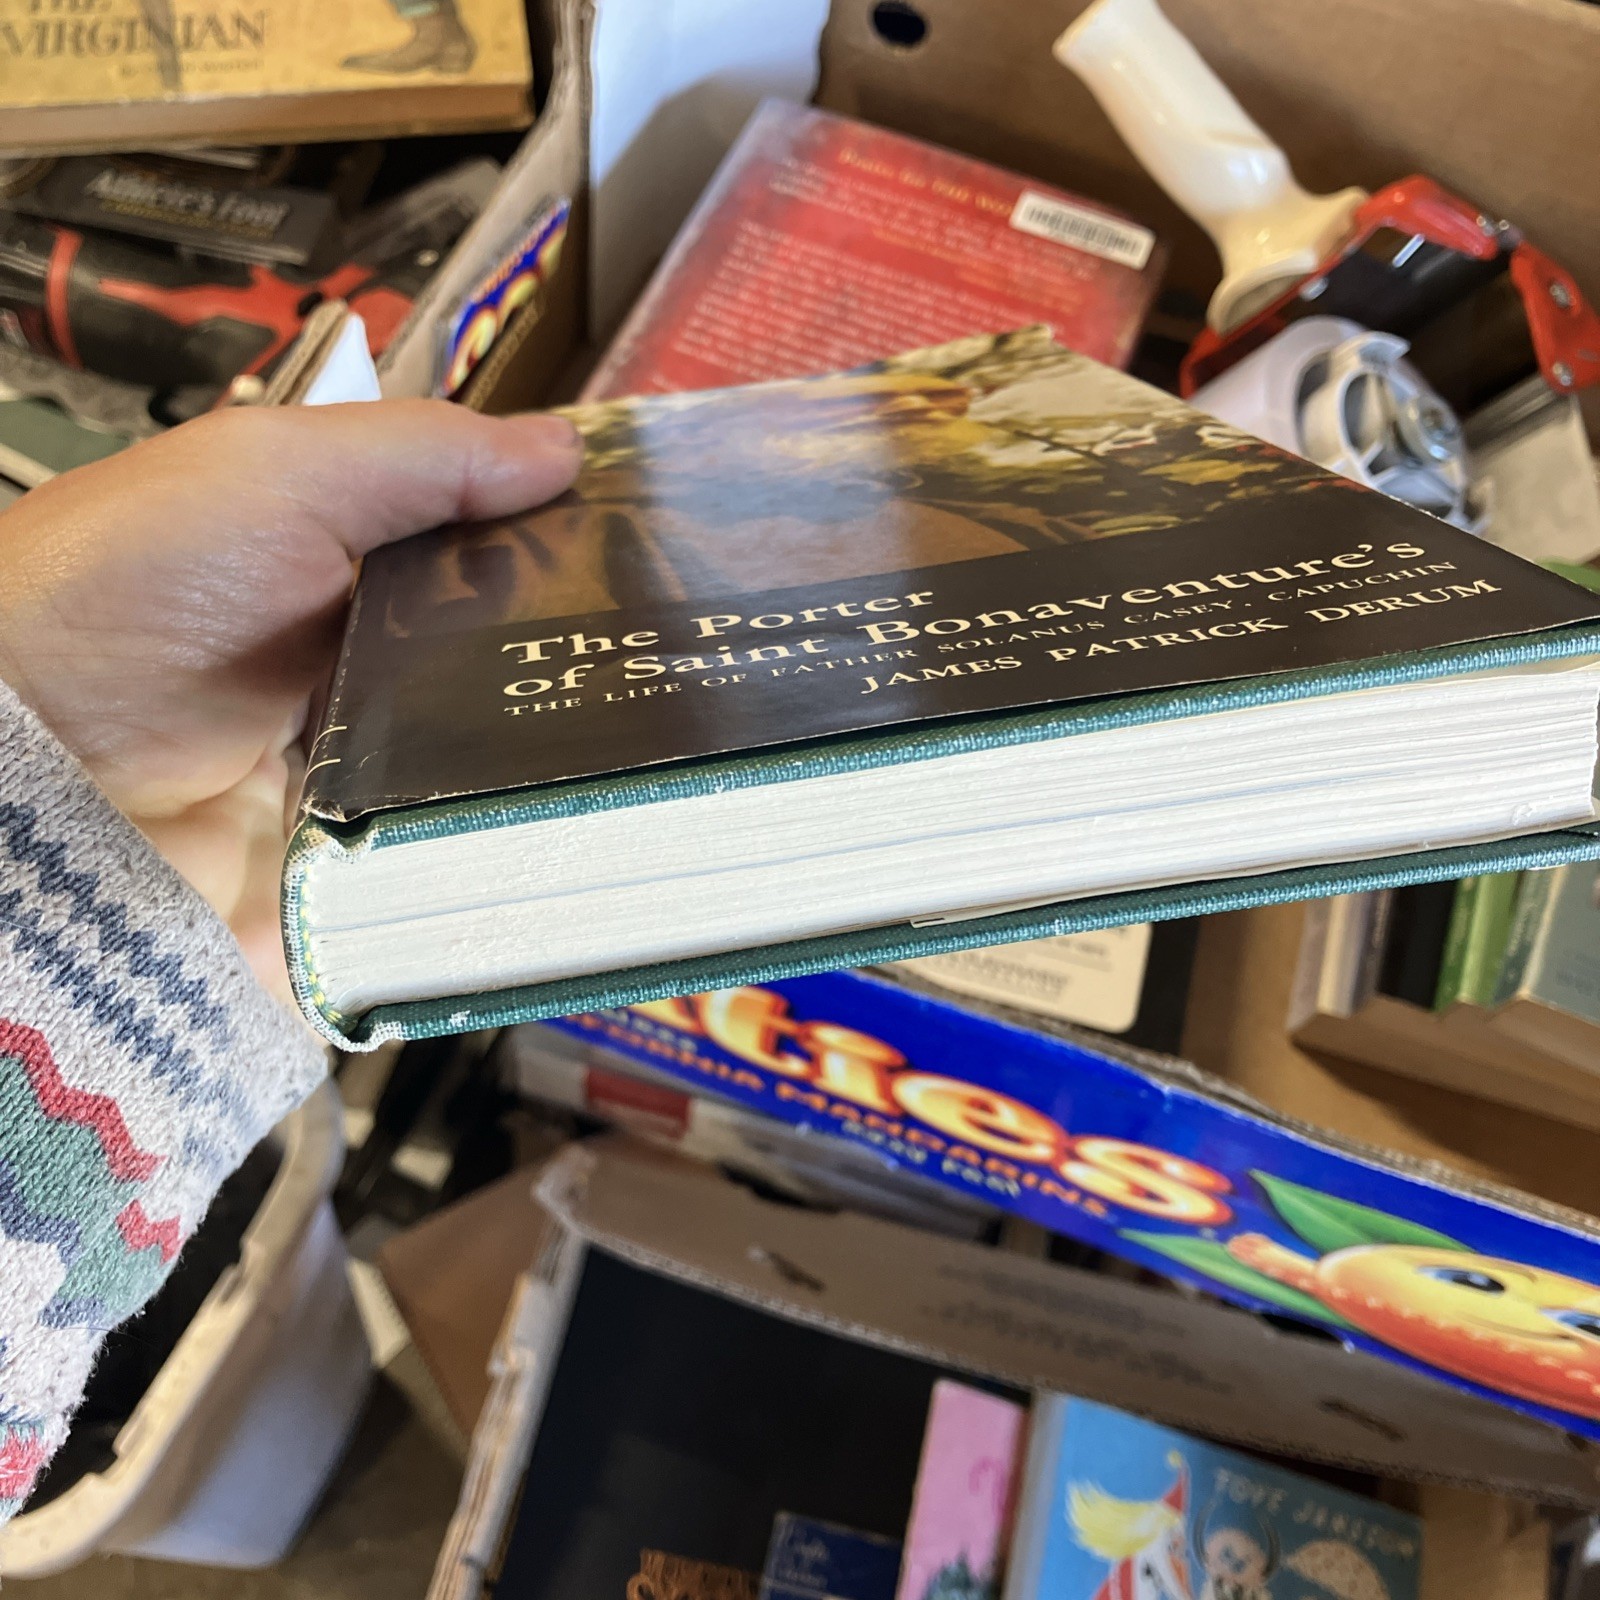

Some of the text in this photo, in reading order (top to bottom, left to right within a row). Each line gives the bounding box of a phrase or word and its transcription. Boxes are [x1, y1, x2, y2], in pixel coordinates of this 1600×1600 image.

[501, 590, 935, 665] The Porter
[502, 540, 1426, 698] of Saint Bonaventure's
[502, 560, 1459, 717] THE LIFE OF FATHER SOLANUS CASEY CAPUCHIN
[859, 578, 1503, 696] JAMES PATRICK DERUM
[622, 984, 1234, 1226] ties
